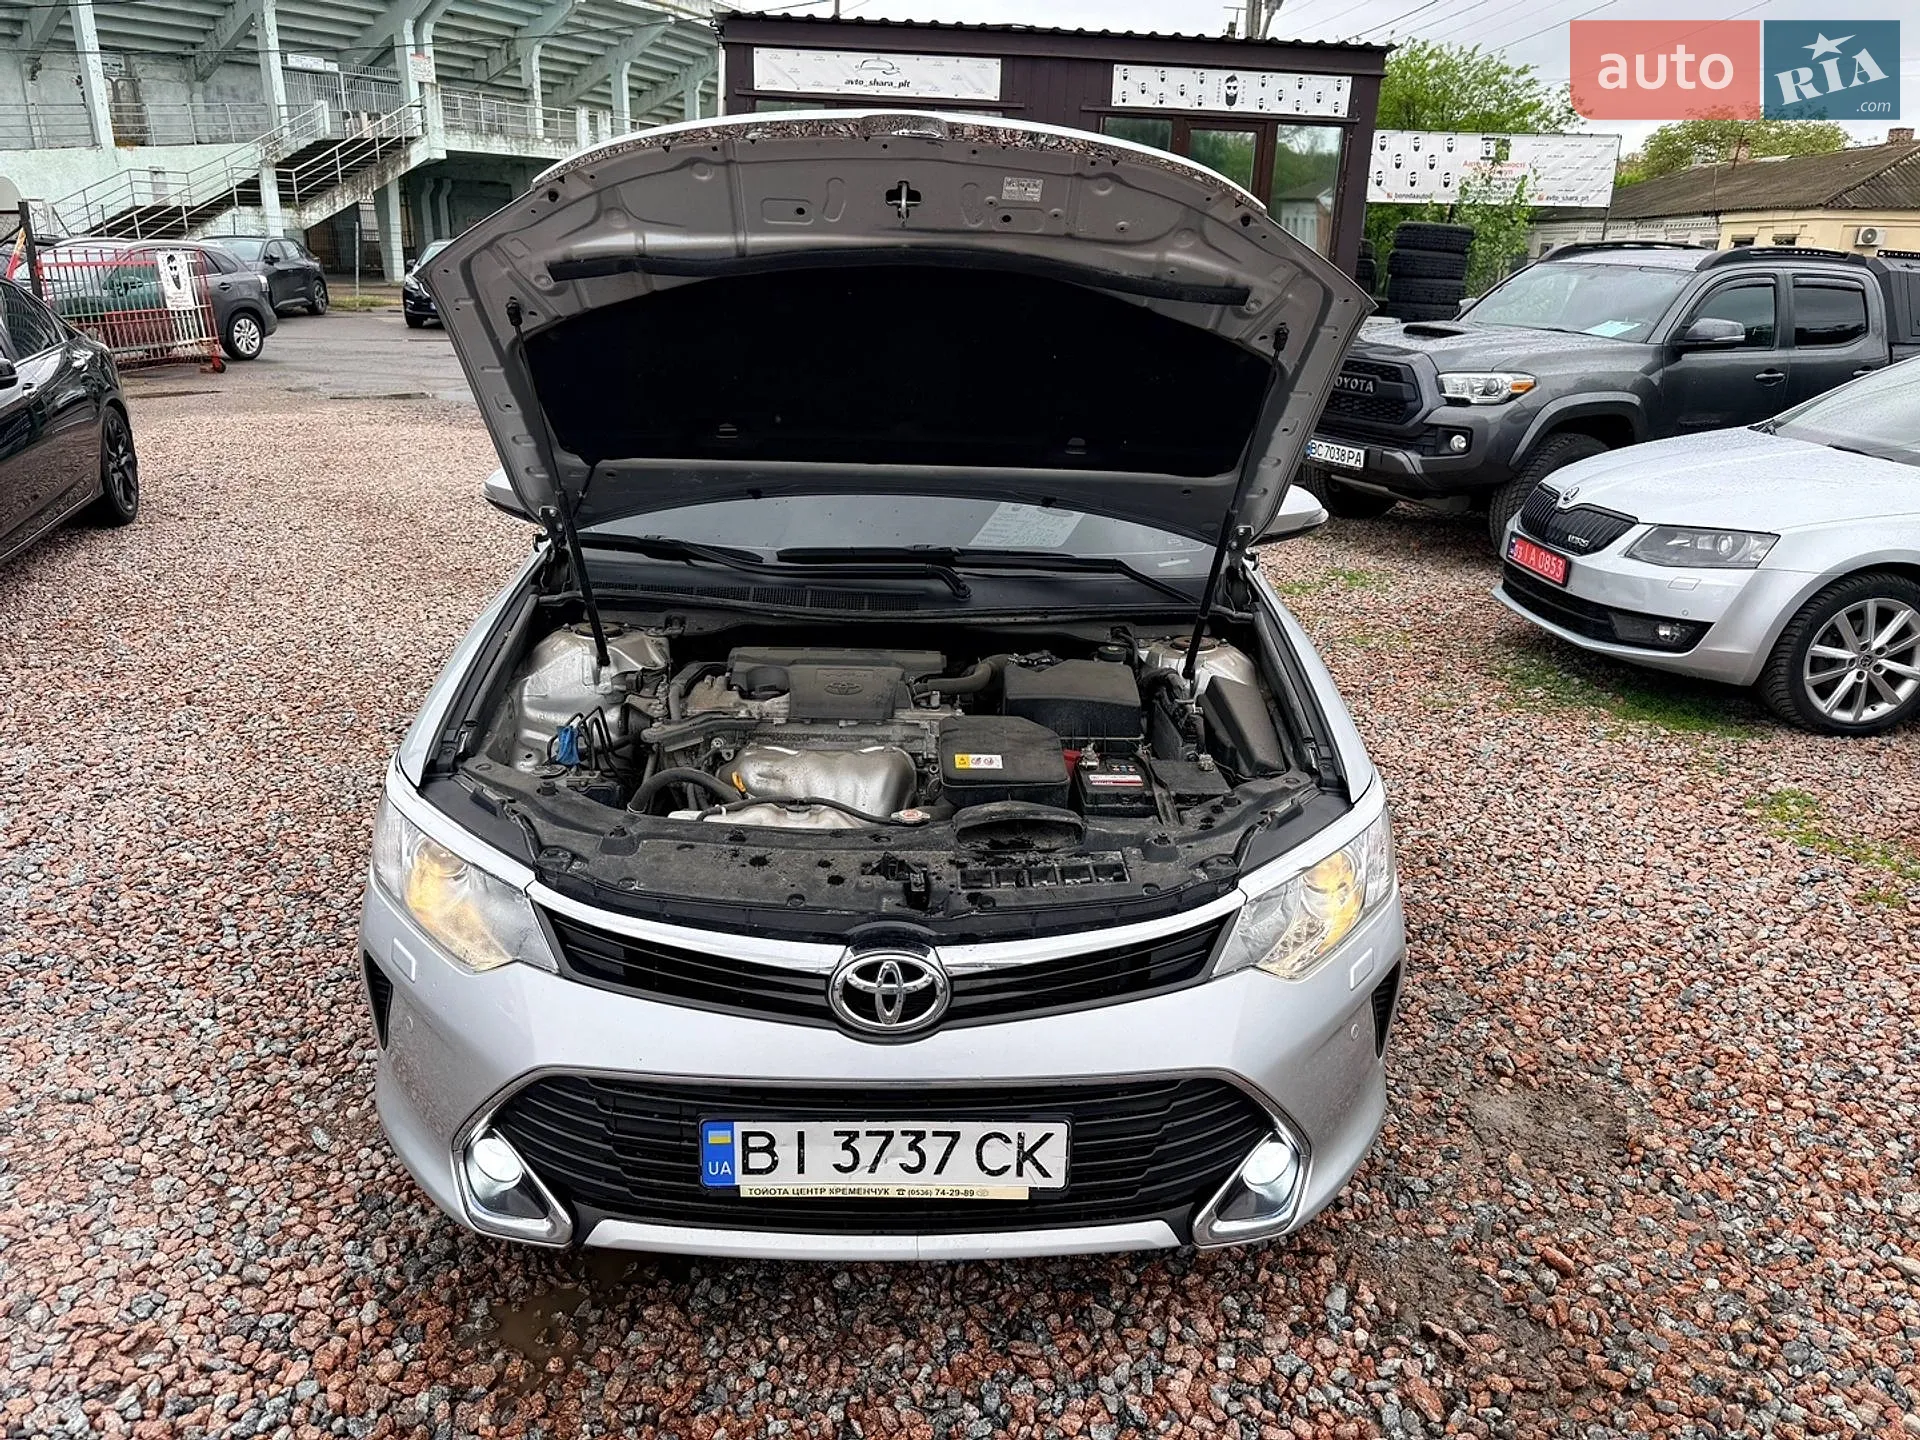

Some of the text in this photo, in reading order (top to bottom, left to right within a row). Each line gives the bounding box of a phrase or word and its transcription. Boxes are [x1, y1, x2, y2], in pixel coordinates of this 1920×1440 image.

[1334, 376, 1374, 394] OYOTA
[1310, 442, 1362, 466] BC 7038 PA
[1538, 551, 1563, 579] 0853
[740, 1130, 1055, 1179] BI 3737 CK
[708, 1161, 732, 1176] UA
[748, 1187, 789, 1196] ТОЙОТА
[792, 1188, 827, 1197] ЦЕНТР
[829, 1188, 890, 1196] КРЕМЕНЧУК
[935, 1189, 975, 1197] 74-29-89
